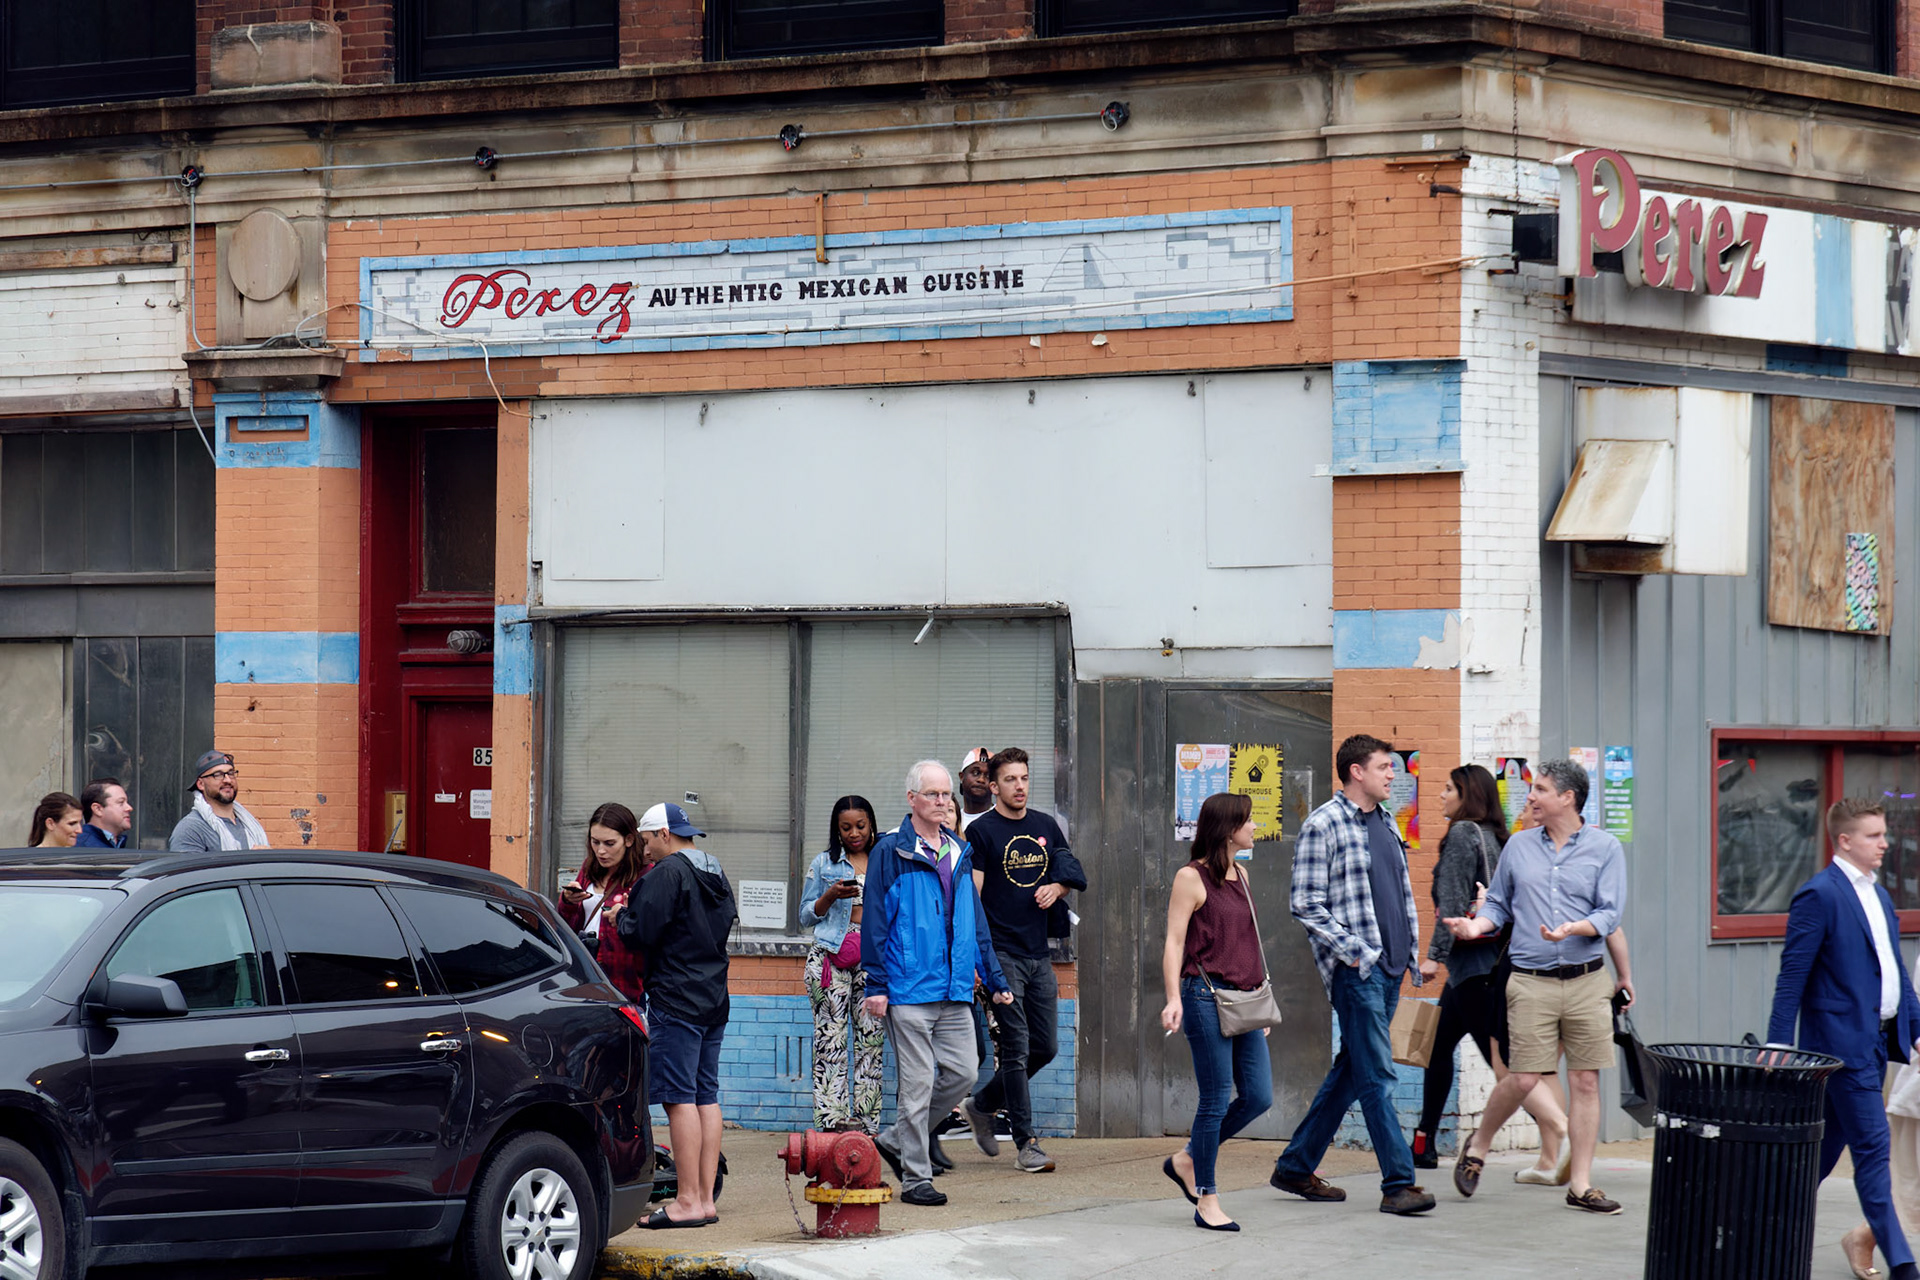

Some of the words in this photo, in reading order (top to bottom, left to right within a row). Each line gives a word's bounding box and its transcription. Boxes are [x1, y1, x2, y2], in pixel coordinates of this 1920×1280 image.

[1568, 148, 1768, 299] Perez
[439, 269, 635, 344] Perez
[648, 282, 783, 308] AUTHENTIC
[798, 276, 908, 300] MEXICAN
[923, 269, 1024, 293] CUISINE
[474, 748, 492, 766] 85
